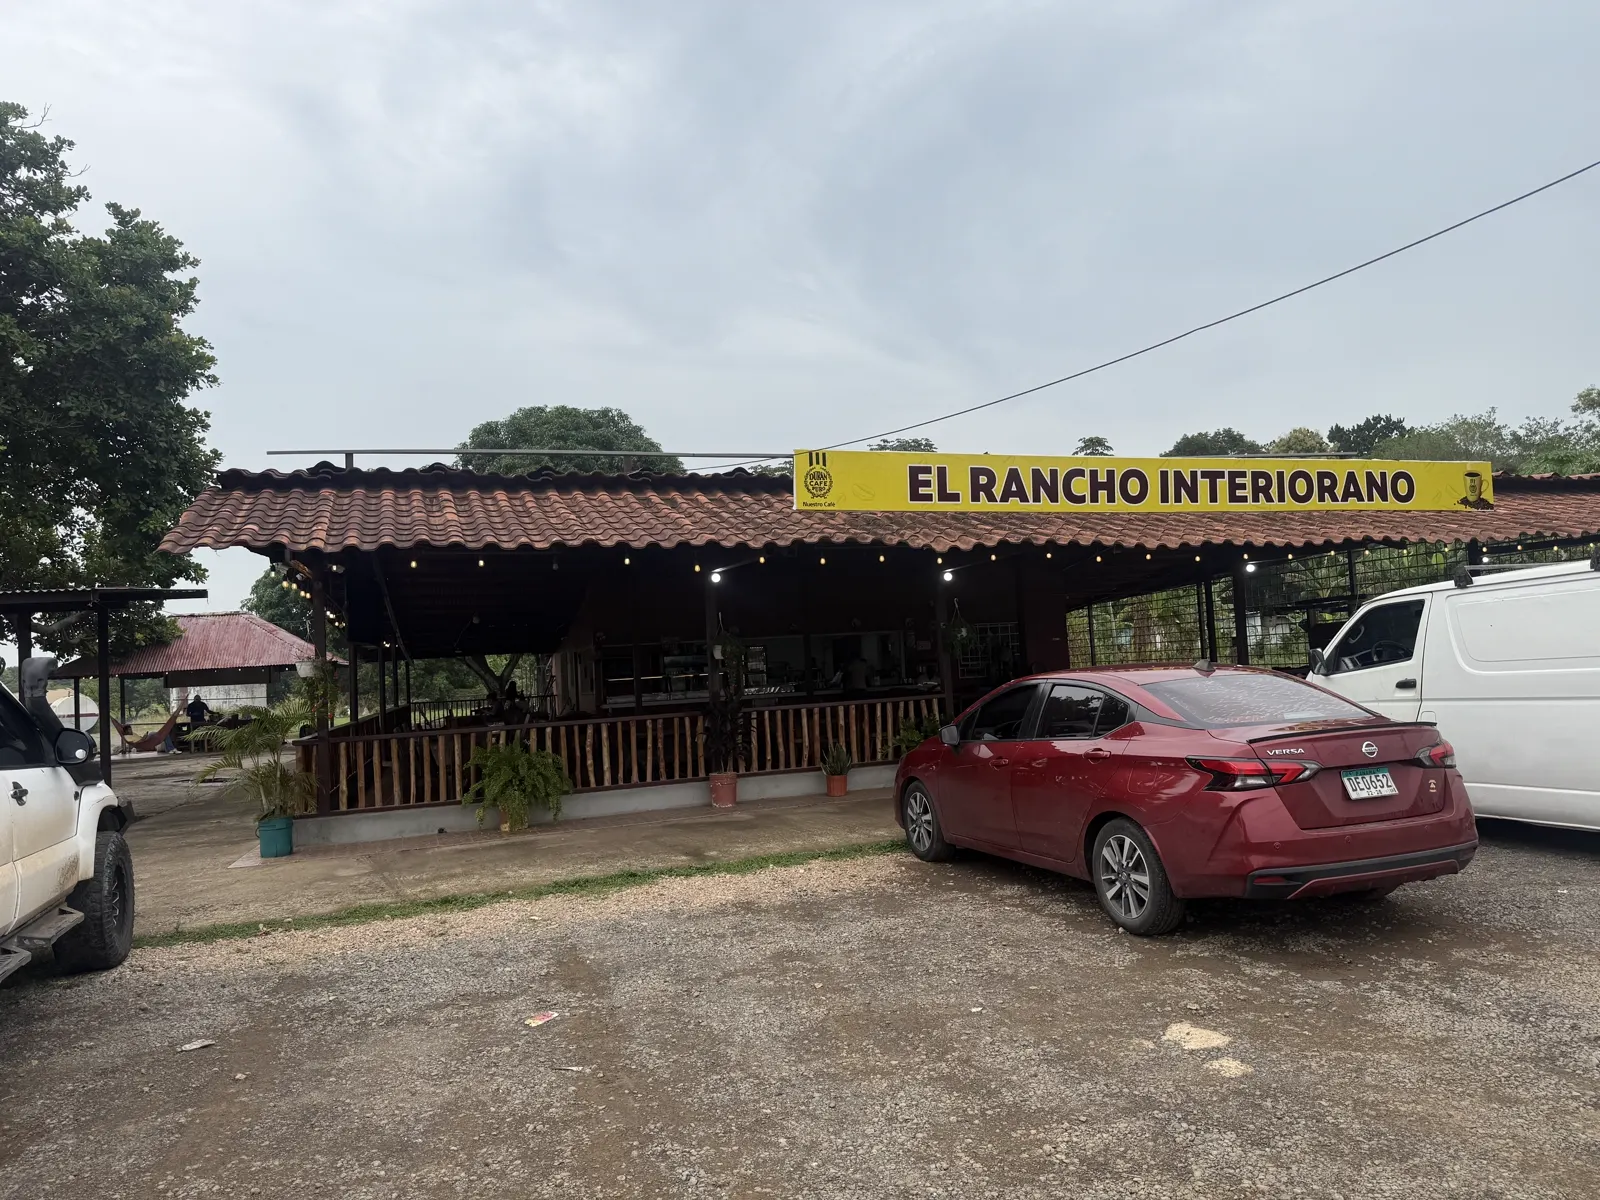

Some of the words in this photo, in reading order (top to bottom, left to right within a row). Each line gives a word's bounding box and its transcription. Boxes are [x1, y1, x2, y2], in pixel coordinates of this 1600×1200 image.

[908, 465, 961, 502] EL
[970, 466, 1149, 505] RANCHO
[1159, 470, 1415, 504] INTERIORANO
